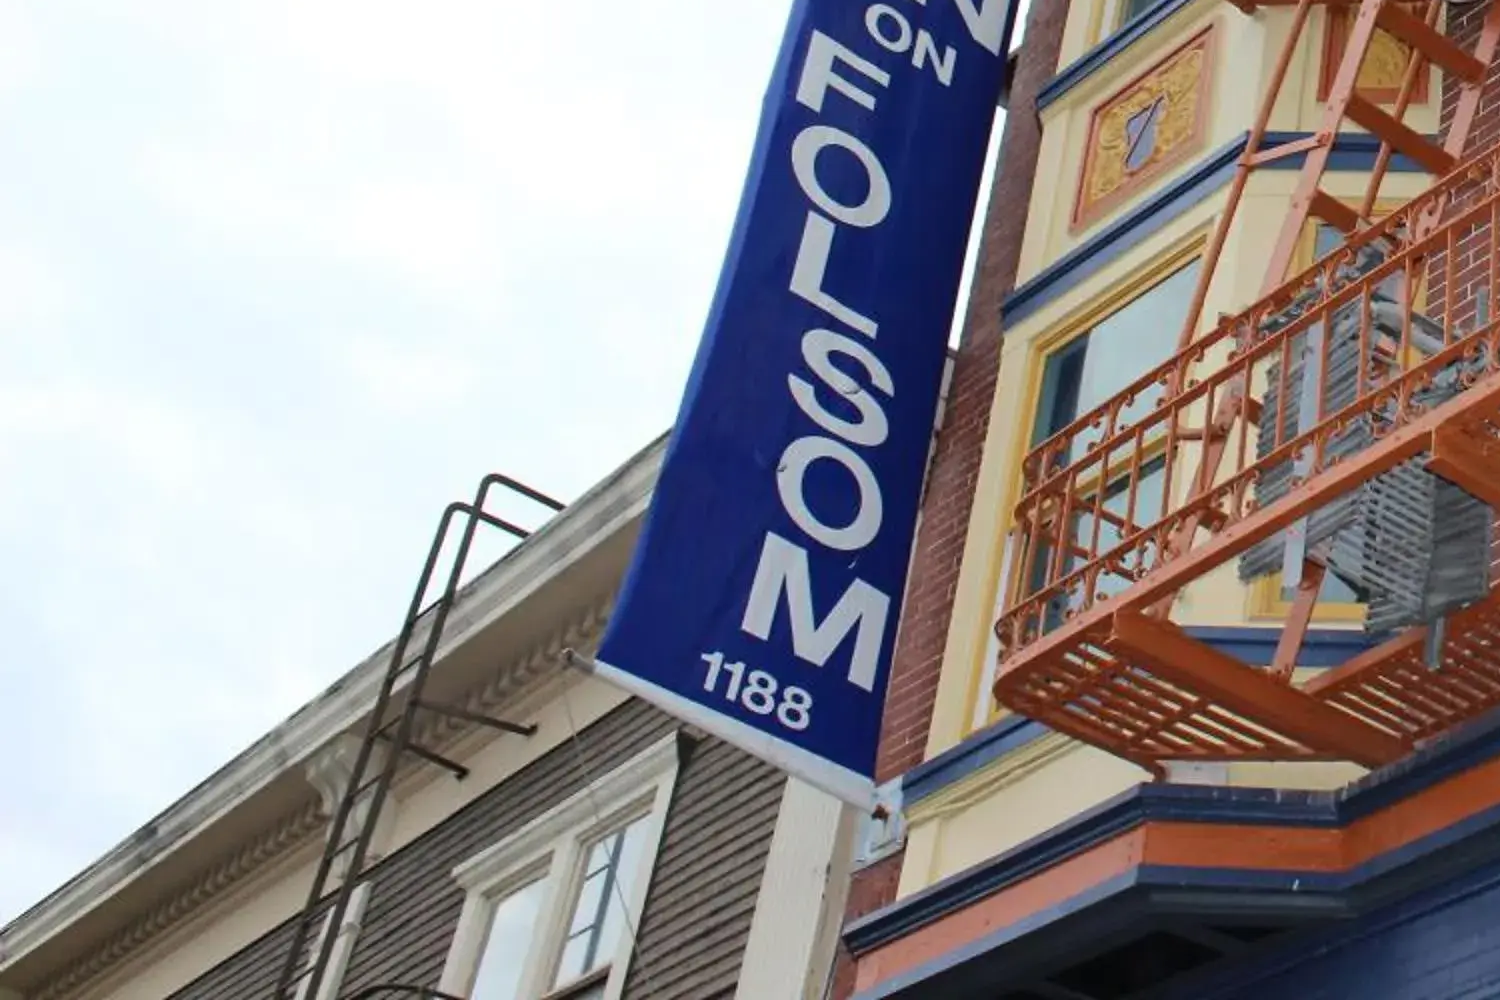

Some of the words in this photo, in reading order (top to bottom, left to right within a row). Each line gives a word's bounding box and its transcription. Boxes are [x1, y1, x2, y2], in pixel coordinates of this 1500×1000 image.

[864, 3, 956, 86] ON
[741, 28, 895, 692] FOLSOM
[701, 650, 812, 731] 1188
